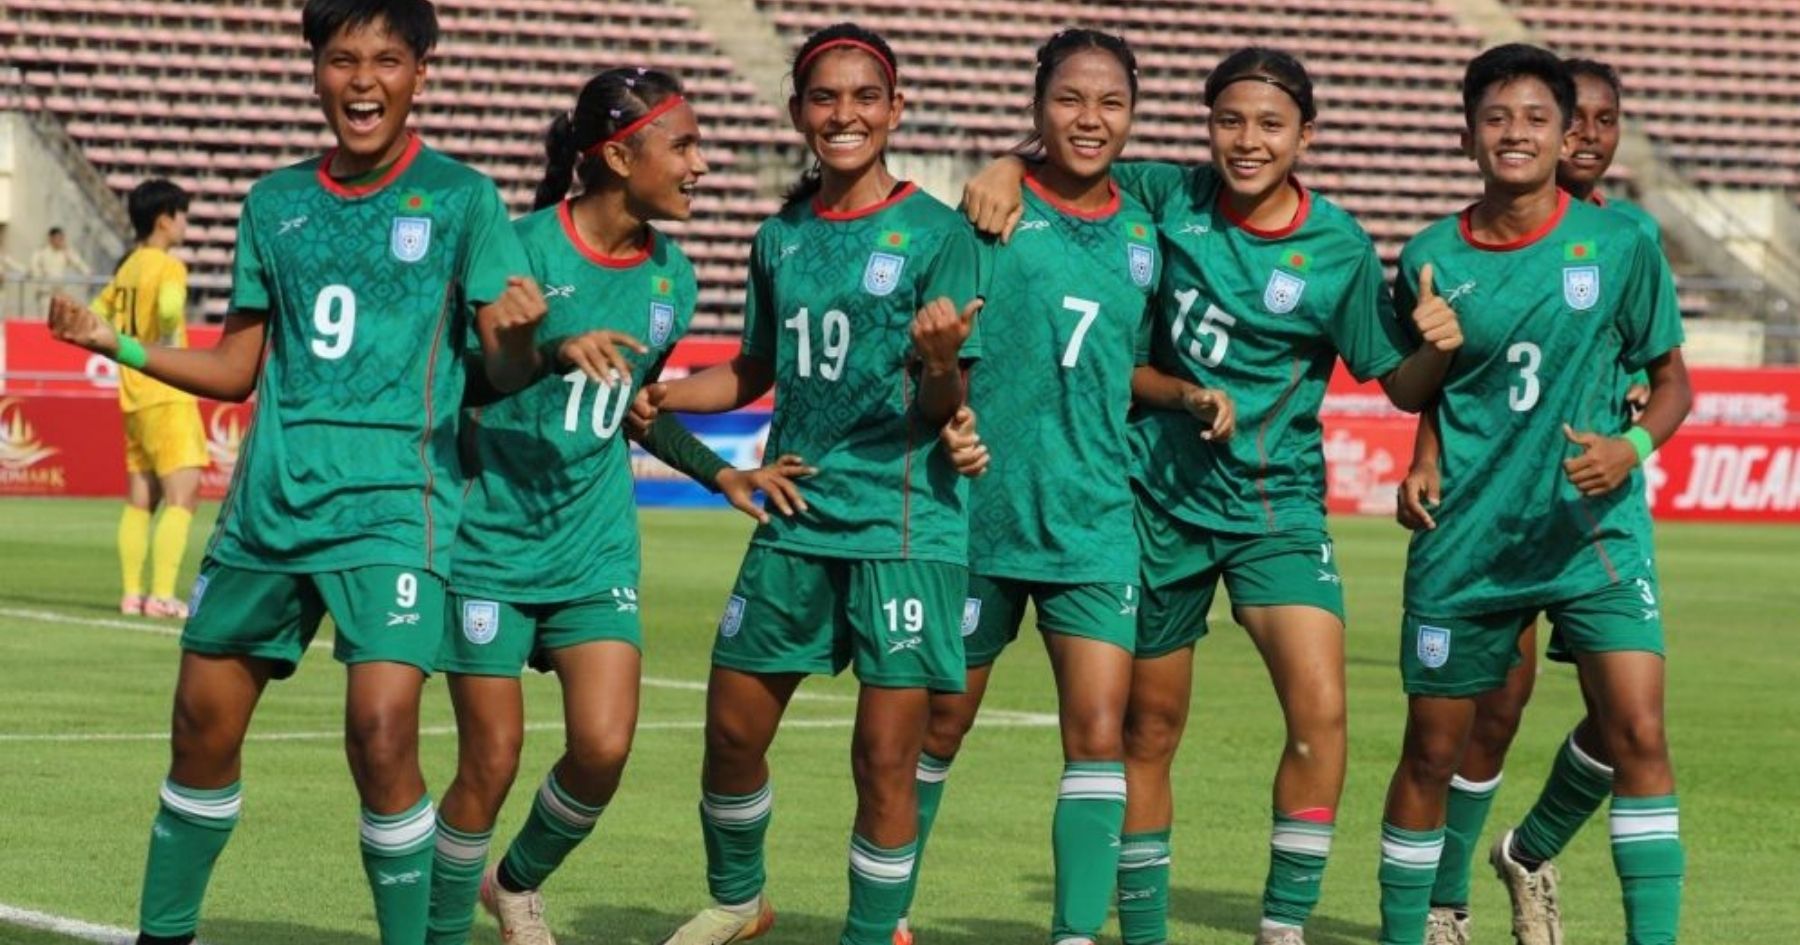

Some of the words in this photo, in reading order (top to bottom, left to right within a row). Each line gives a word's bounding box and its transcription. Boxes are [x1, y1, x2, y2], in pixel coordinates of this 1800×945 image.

[312, 285, 356, 359] 9
[785, 307, 850, 382] 19
[1062, 296, 1100, 368] 7
[1171, 288, 1236, 368] 15
[563, 367, 632, 439] 10
[1507, 342, 1542, 412] 3
[396, 572, 417, 608] 9
[882, 598, 923, 632] 19
